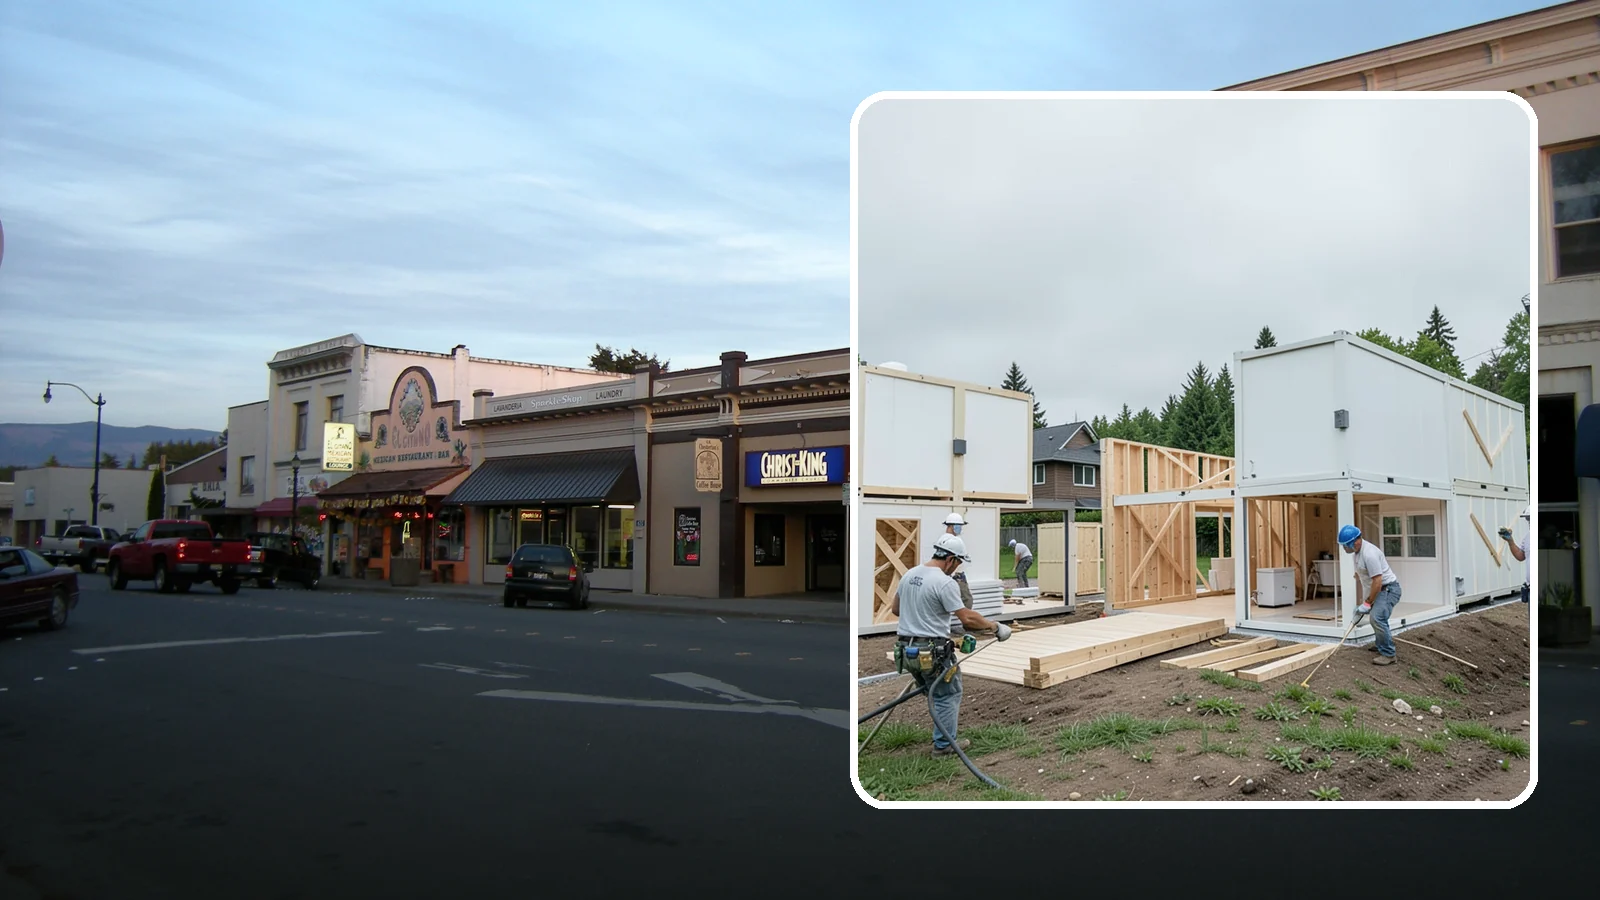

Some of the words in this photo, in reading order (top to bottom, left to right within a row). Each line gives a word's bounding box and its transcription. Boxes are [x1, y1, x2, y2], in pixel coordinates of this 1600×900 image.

[493, 402, 522, 412] LAVANDERIA
[595, 389, 623, 400] LAUNDRY
[397, 451, 434, 462] RESTAURANT
[438, 450, 450, 459] BAR
